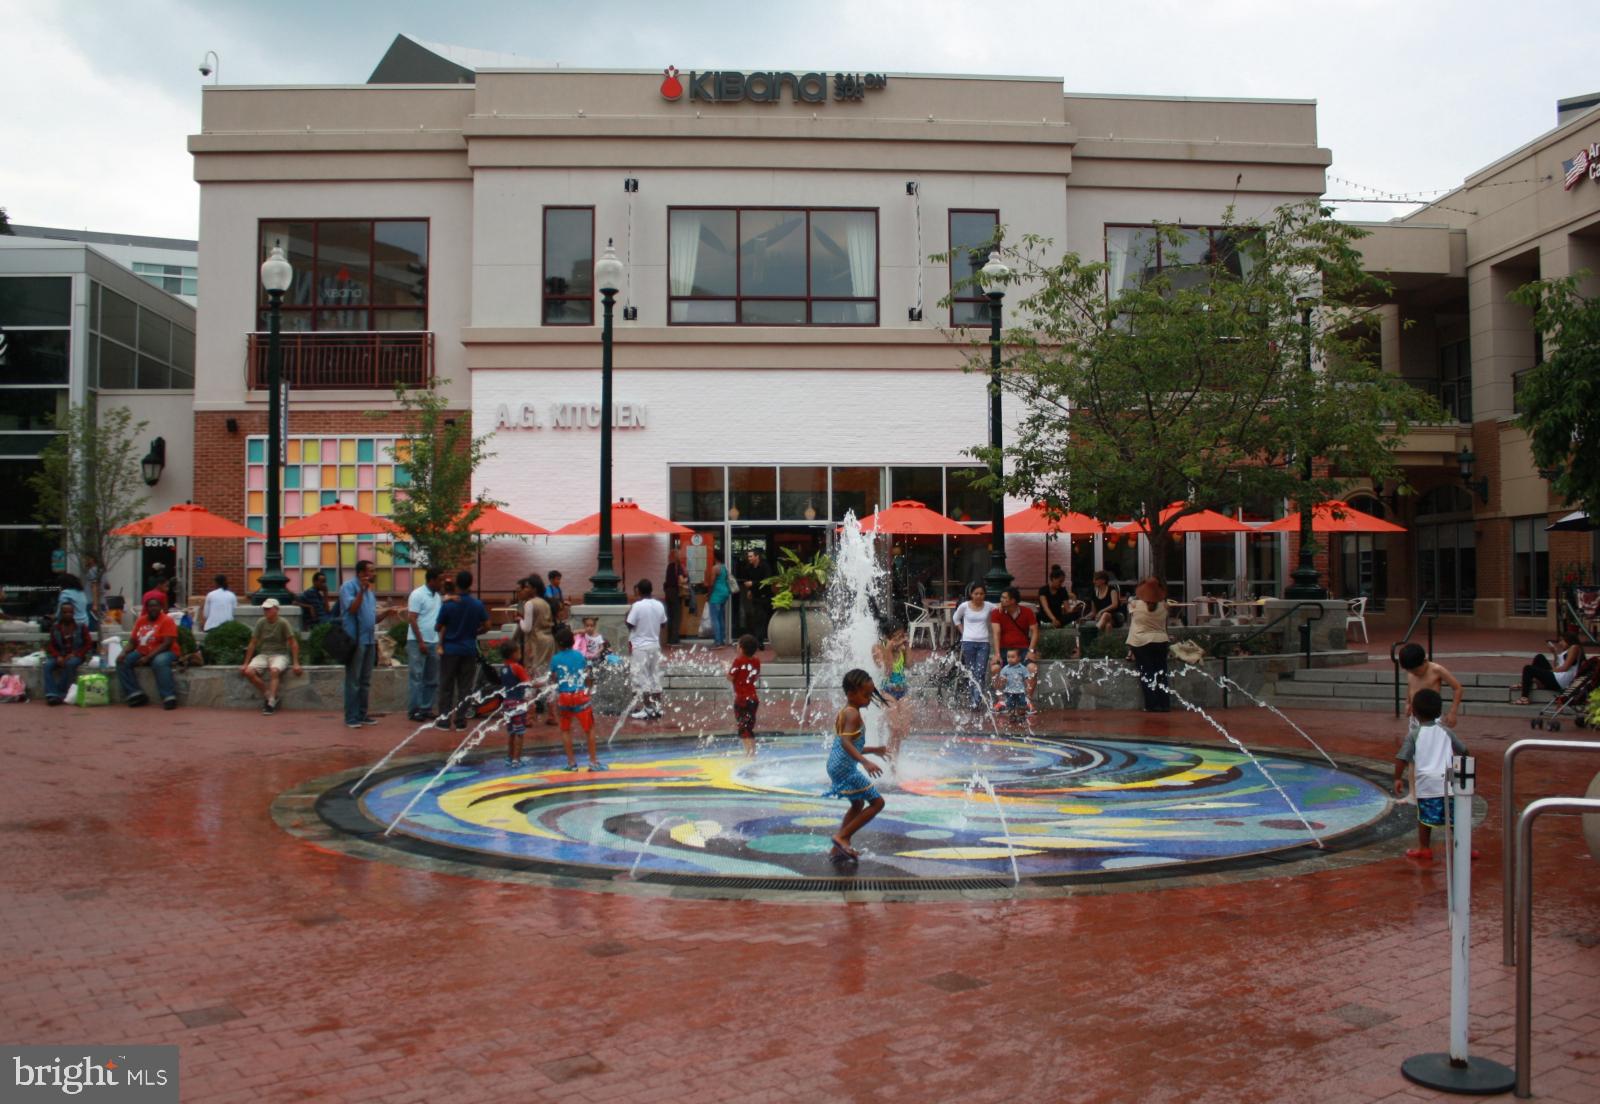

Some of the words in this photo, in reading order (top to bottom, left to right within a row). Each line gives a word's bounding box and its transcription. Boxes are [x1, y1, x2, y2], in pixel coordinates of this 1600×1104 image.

[834, 72, 887, 90] SALON
[496, 402, 543, 430] A.G.
[144, 537, 176, 548] 931-A
